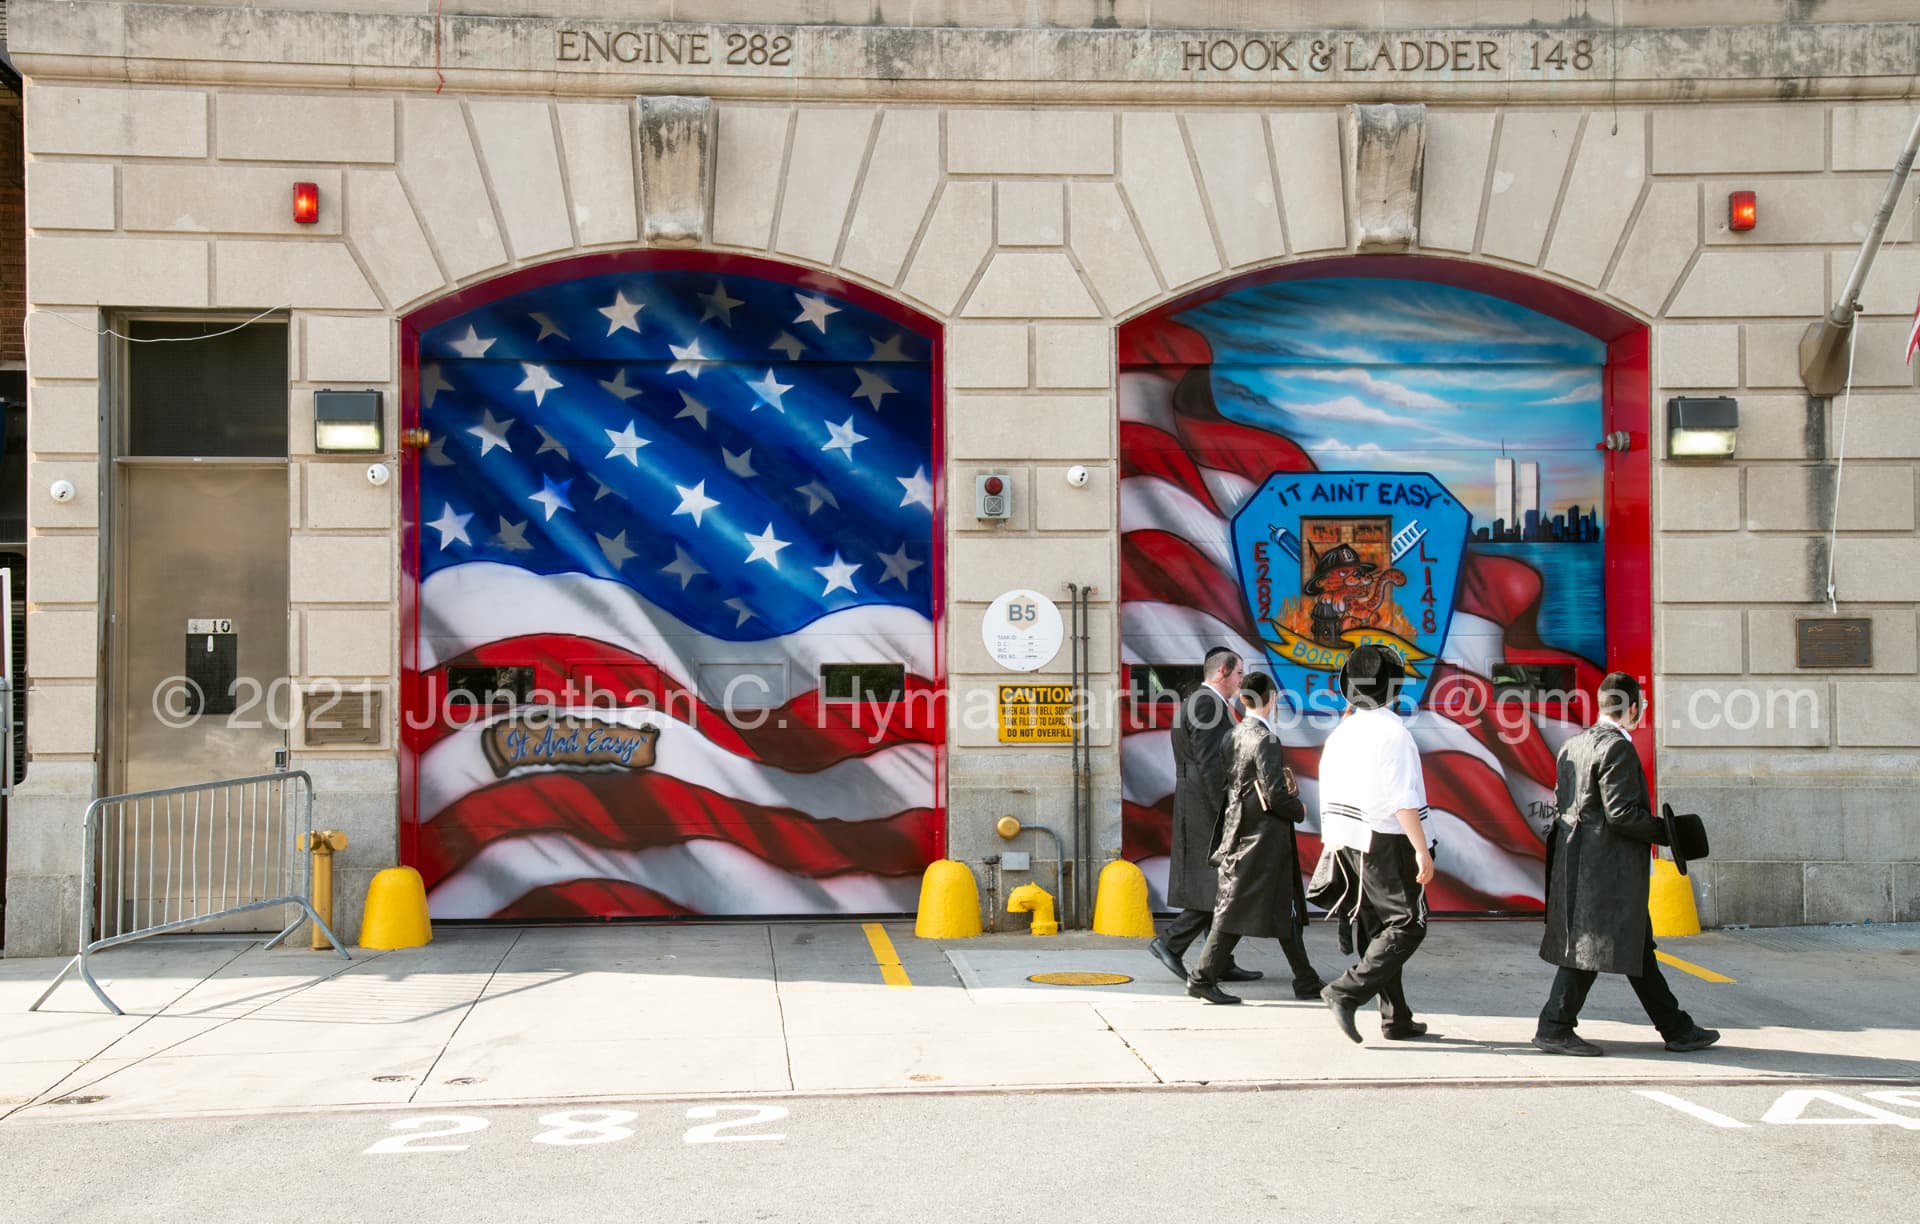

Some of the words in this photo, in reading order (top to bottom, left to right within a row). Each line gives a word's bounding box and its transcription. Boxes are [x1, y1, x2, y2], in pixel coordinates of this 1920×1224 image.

[556, 31, 711, 65] ENGINE
[727, 33, 792, 66] 282
[1181, 39, 1300, 72] HOOK
[1308, 40, 1336, 72] &
[1343, 41, 1502, 72] LADDER
[1529, 39, 1594, 71] 148
[1311, 478, 1369, 502] AIN'T
[1254, 542, 1272, 623] E282
[1420, 540, 1438, 634] L148
[1009, 604, 1036, 621] B5
[212, 620, 230, 633] 10
[1001, 687, 1073, 702] CAUTION
[1040, 706, 1053, 715] BELL
[1040, 716, 1046, 726] TO
[1007, 728, 1017, 738] DO
[1020, 728, 1033, 738] NOT
[1038, 728, 1072, 738] OVERFILL
[1528, 800, 1555, 820] IND
